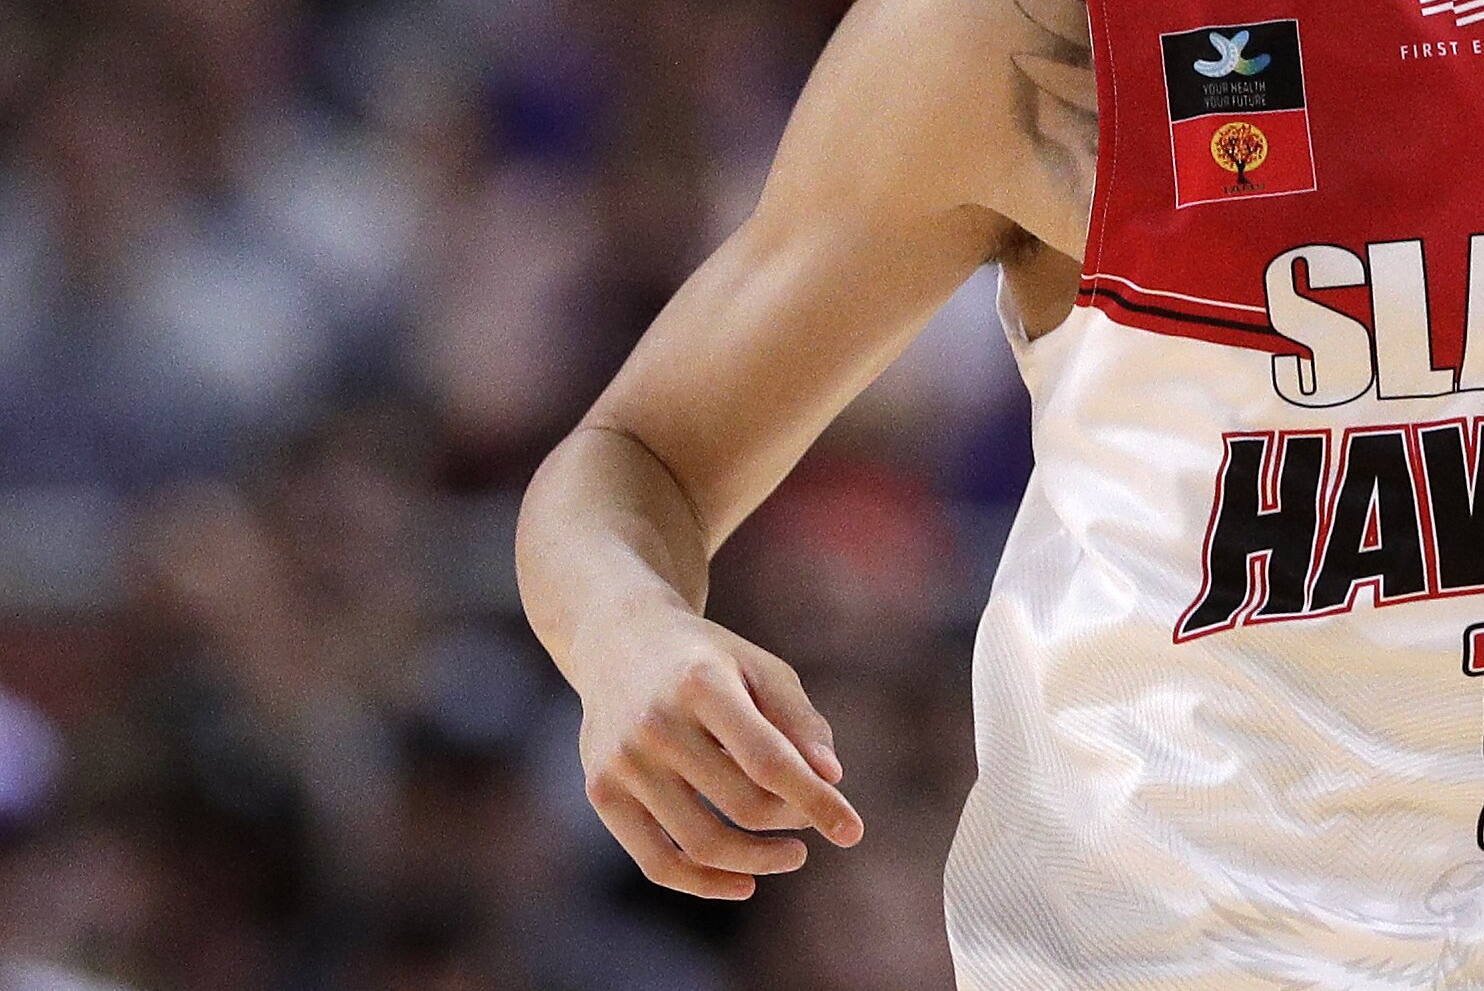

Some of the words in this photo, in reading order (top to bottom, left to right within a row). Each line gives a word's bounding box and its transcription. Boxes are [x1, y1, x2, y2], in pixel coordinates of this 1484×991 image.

[1400, 41, 1458, 60] FIRST
[1202, 83, 1229, 95] YOUR
[1230, 81, 1266, 94] HEALTH
[1204, 95, 1230, 109] YOUR
[1231, 93, 1267, 107] FUTURE
